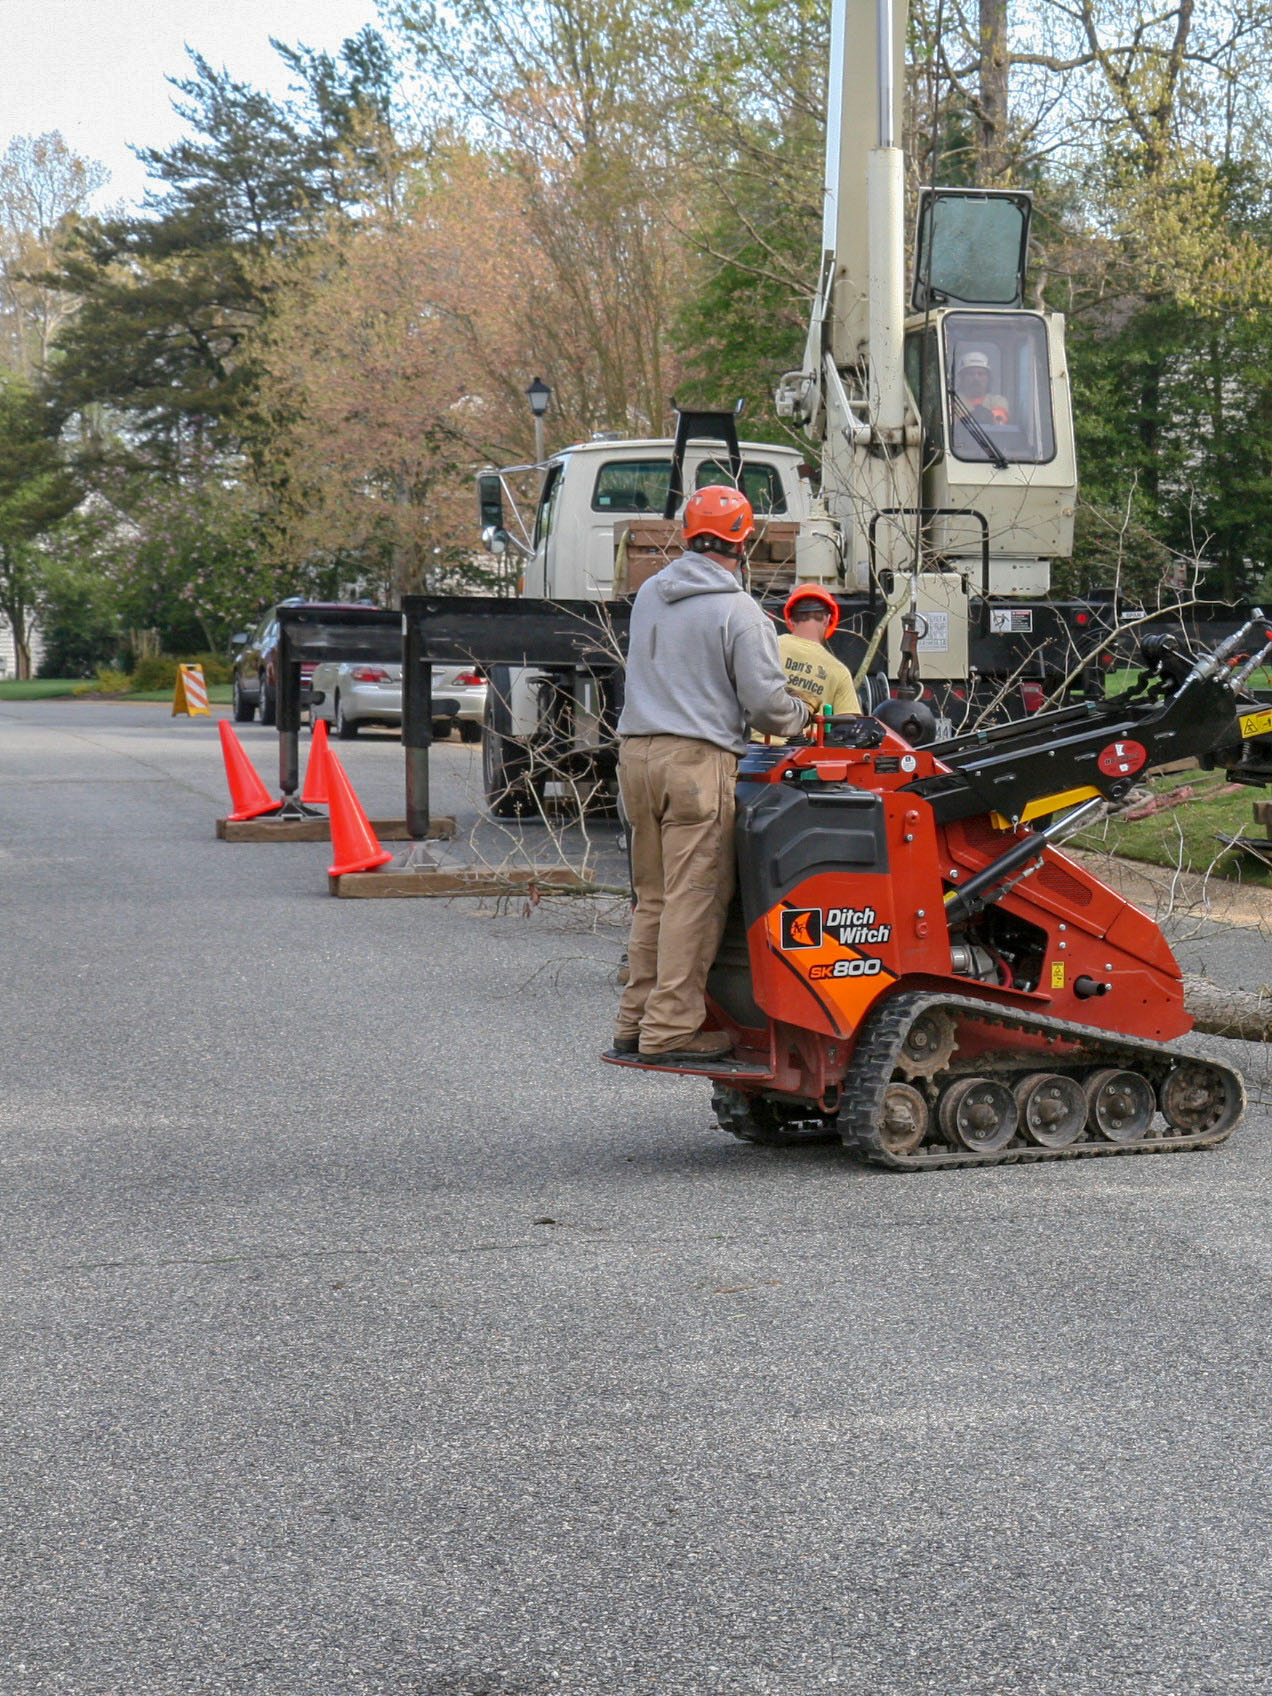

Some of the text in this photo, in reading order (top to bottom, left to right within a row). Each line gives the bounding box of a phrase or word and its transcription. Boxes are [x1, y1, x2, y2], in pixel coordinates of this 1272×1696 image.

[784, 656, 813, 674] Dan's
[826, 907, 876, 927] Ditch
[839, 925, 890, 945] Witch
[809, 958, 882, 980] SK800
